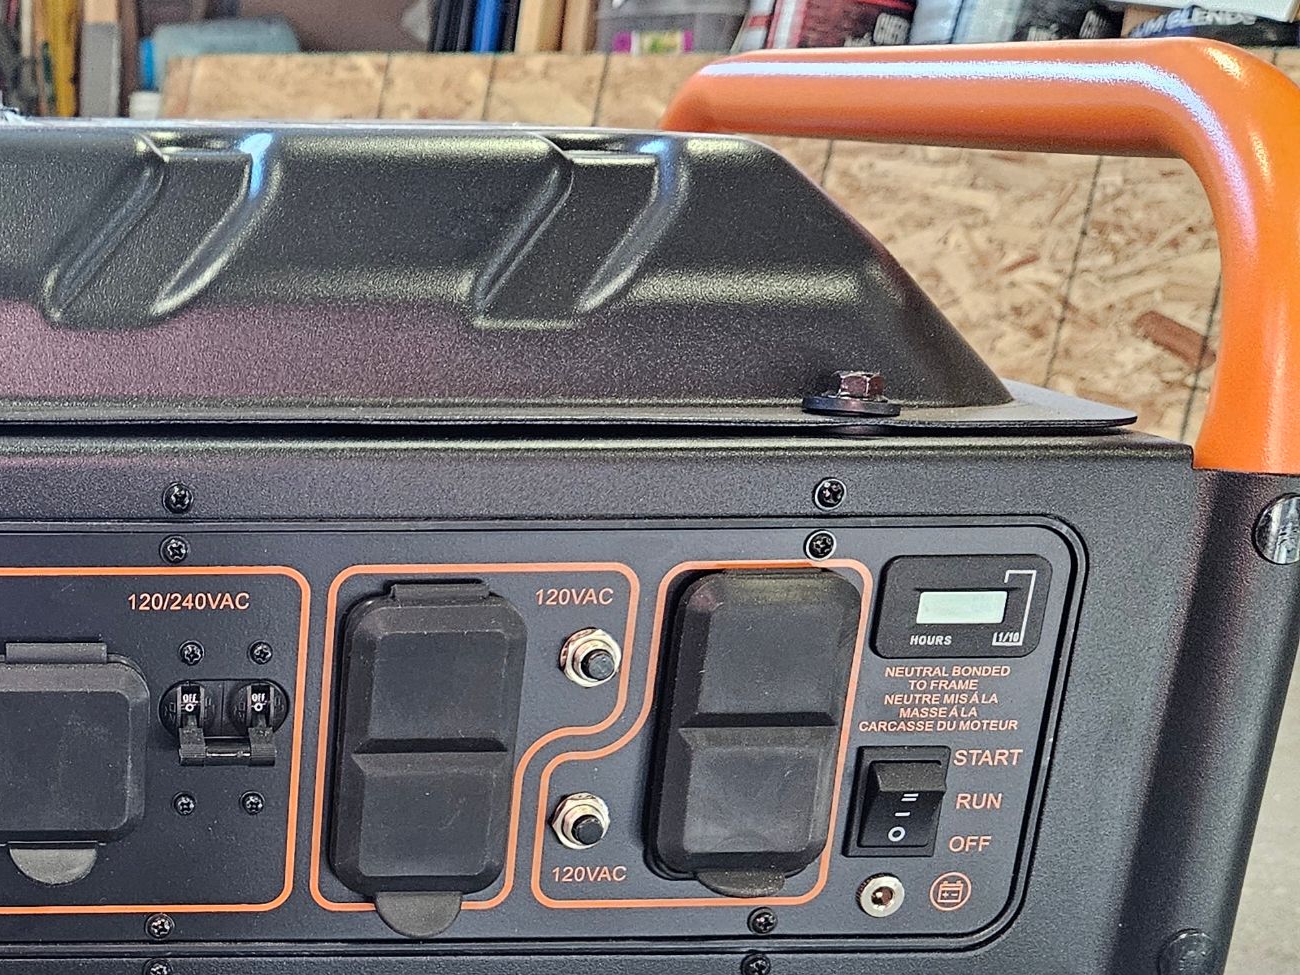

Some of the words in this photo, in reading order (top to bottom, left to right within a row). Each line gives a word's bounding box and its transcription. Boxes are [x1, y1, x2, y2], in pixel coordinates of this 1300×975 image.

[128, 592, 250, 612] 120/240VAC
[535, 588, 614, 605] 120VAC
[909, 635, 952, 645] HOURS
[998, 632, 1020, 642] 1/10
[885, 667, 949, 677] NEUTRAL
[952, 666, 1011, 676] BONDED
[909, 680, 927, 690] TO
[930, 680, 978, 690] FRAME
[884, 694, 940, 704] NEUTRE
[943, 694, 968, 704] MIS
[981, 693, 998, 703] LA
[899, 707, 947, 718] MASSE
[960, 707, 978, 717] LA
[859, 721, 934, 731] CARCASSE
[936, 720, 956, 731] DU
[959, 720, 1018, 731] MOTEUR
[953, 749, 1023, 766] START
[956, 793, 1003, 809] RUN
[948, 835, 992, 852] OFF
[552, 866, 627, 883] 120VAC
